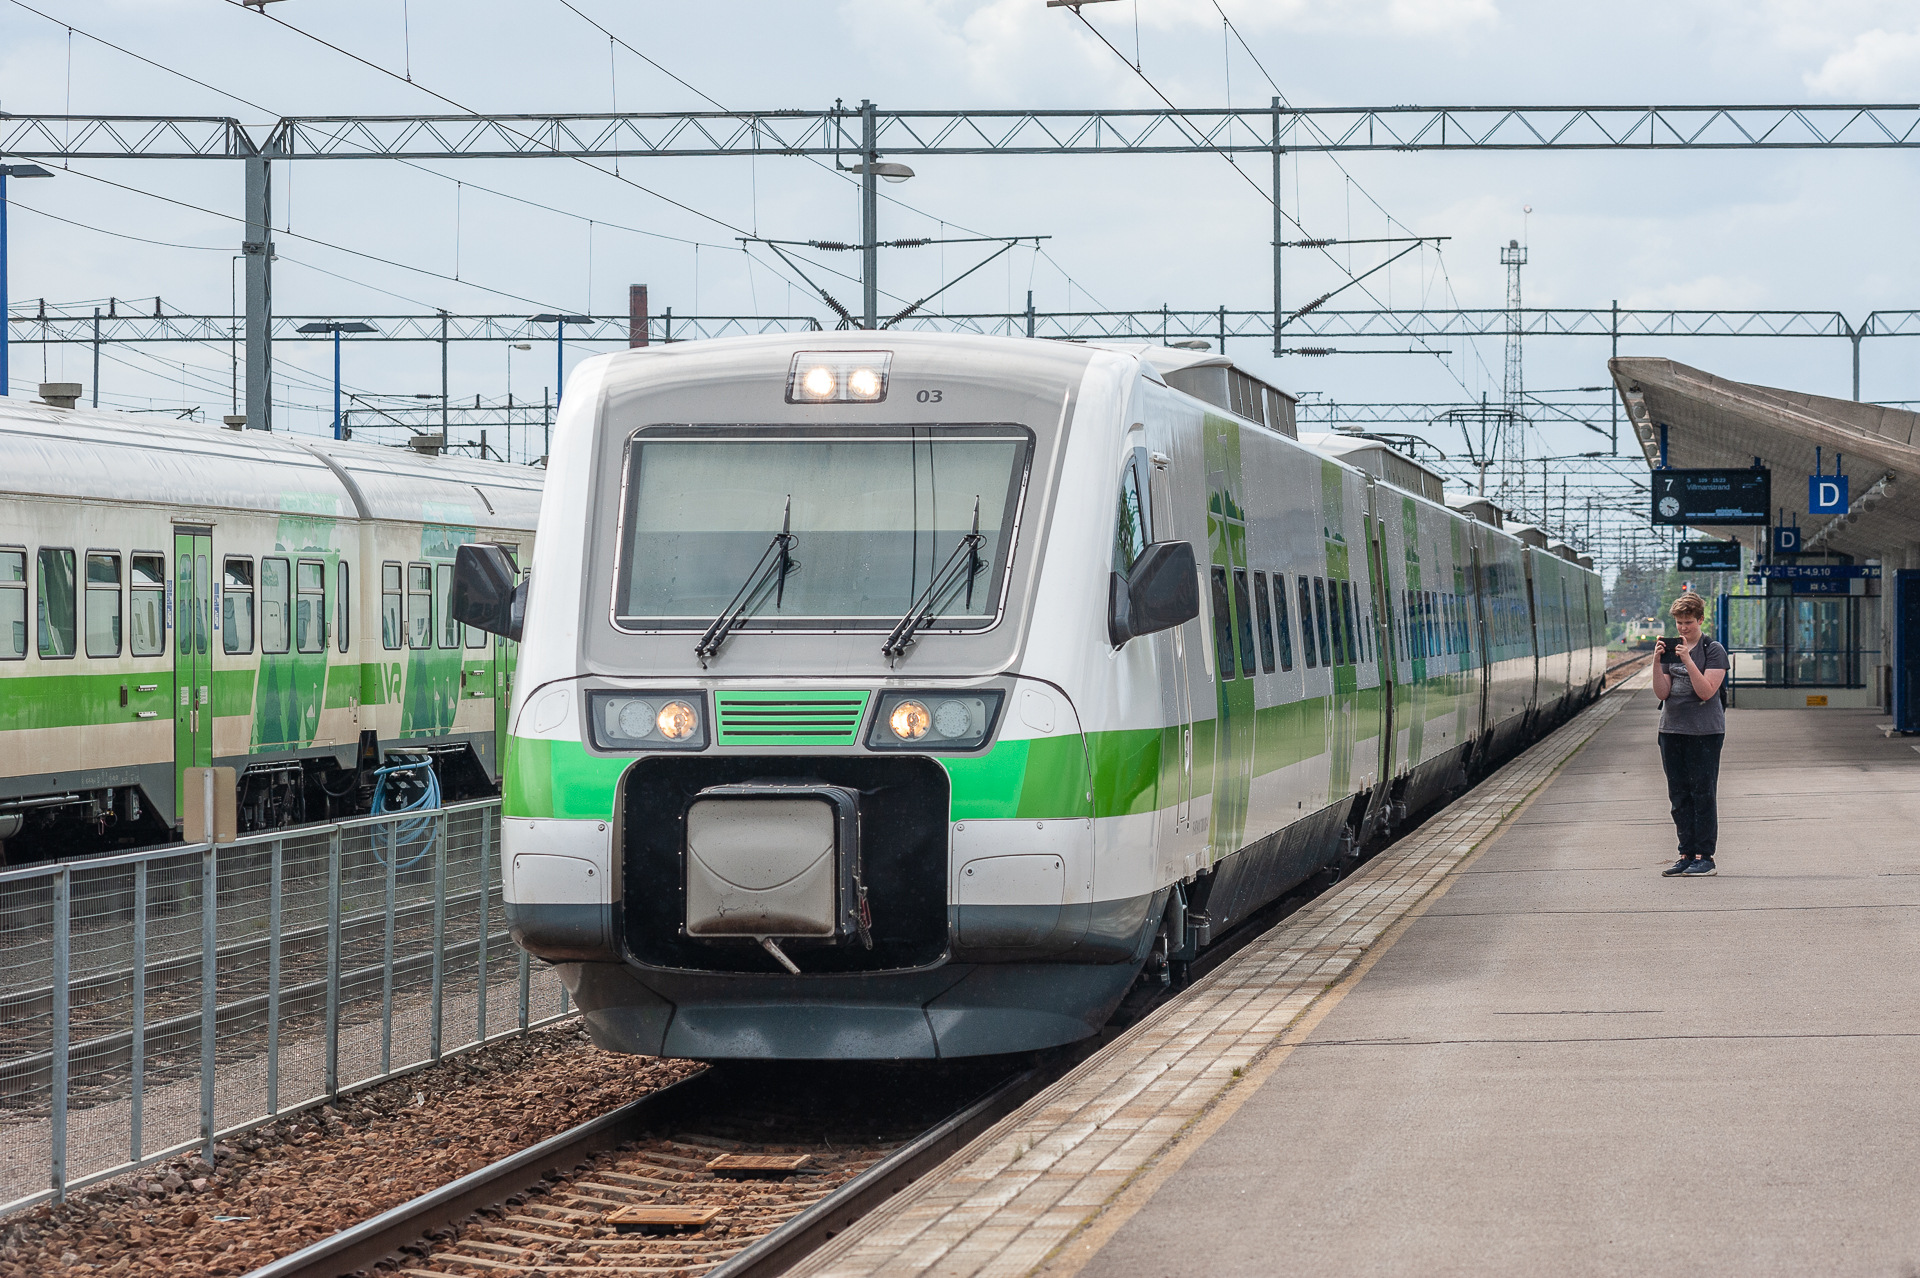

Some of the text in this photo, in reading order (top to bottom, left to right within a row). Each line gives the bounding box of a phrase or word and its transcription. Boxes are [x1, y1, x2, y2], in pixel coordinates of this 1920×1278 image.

[916, 389, 943, 403] 03
[1664, 479, 1674, 492] 7
[1819, 482, 1840, 507] D
[1781, 531, 1795, 548] D
[1684, 546, 1690, 554] 7
[380, 662, 403, 705] VR
